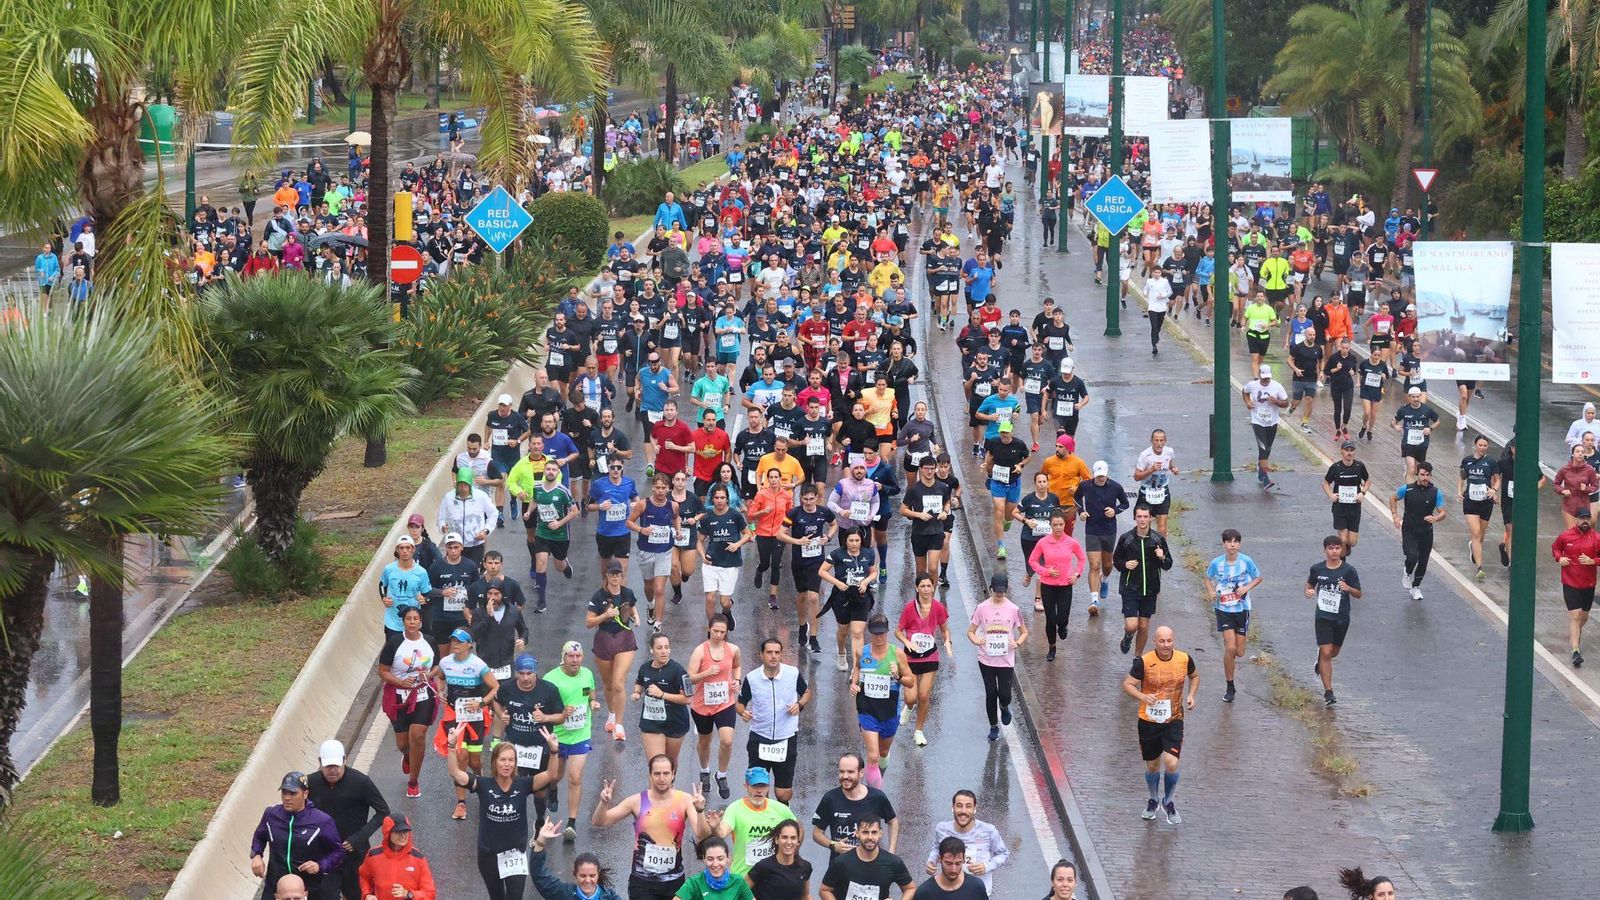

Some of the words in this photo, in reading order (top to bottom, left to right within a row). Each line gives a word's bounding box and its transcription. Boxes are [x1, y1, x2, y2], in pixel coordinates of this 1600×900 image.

[488, 209, 509, 218] RED
[989, 642, 1005, 650] 7008
[866, 683, 888, 691] 13790
[709, 690, 726, 699] 3641
[1149, 708, 1167, 717] 7257
[762, 747, 785, 755] 11097
[518, 752, 538, 760] 5480
[504, 858, 525, 868] 1371
[647, 855, 674, 865] 10143
